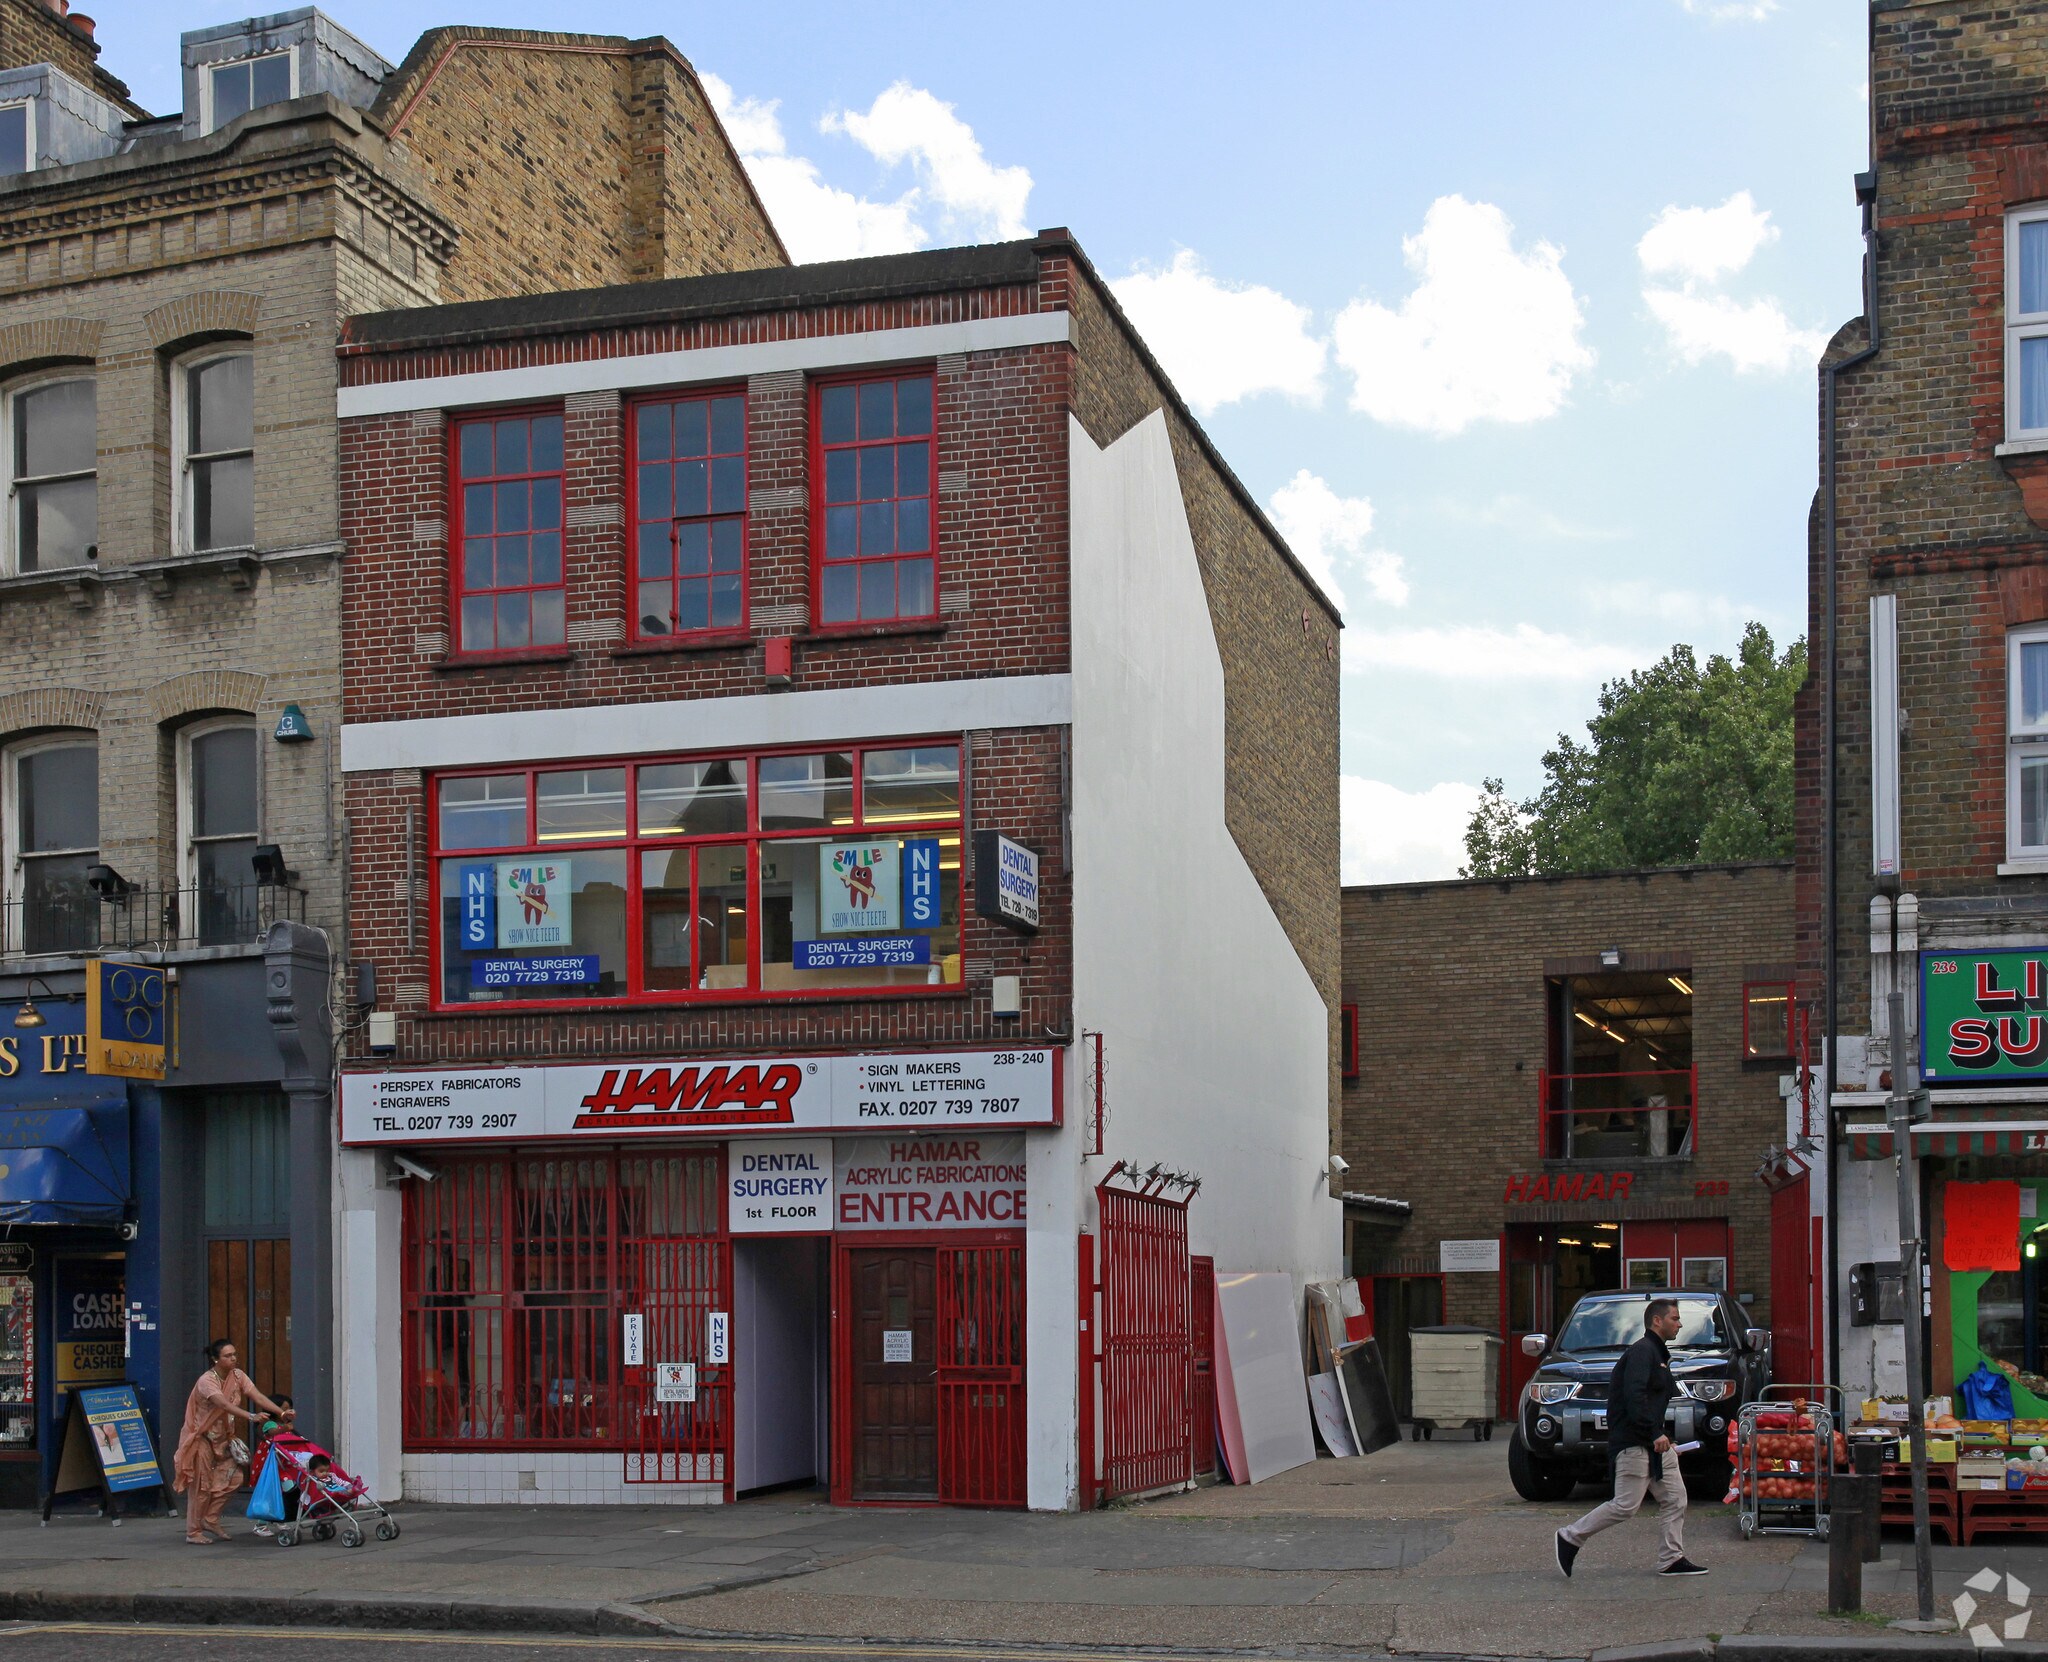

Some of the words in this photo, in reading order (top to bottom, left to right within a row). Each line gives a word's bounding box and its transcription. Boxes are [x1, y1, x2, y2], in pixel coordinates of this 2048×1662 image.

[1002, 844, 1033, 877] DENTAL
[912, 847, 931, 920] NHS
[1000, 868, 1037, 902] SURGERY
[468, 872, 486, 942] NHS
[832, 912, 849, 928] SHOW
[850, 911, 865, 927] NICE
[866, 910, 887, 926] TEETH
[508, 928, 525, 944] SHOW
[525, 928, 540, 943] NICE
[540, 926, 560, 942] TEETH
[808, 942, 853, 954] DENTAL
[857, 939, 914, 951] SURGERY
[485, 961, 528, 972] DENTAL
[531, 958, 584, 970] SURGERY
[808, 955, 835, 966] 020
[840, 953, 876, 965] 7729
[881, 951, 915, 963] 7319
[1931, 960, 1957, 975] 236
[485, 973, 511, 984] 020
[516, 971, 549, 982] 7729
[554, 970, 585, 981] 7319
[993, 1052, 1045, 1065] 238-240
[867, 1064, 898, 1076] SIGN
[906, 1062, 961, 1074] MAKERS
[380, 1080, 434, 1093] PERSPEX
[441, 1077, 521, 1091] FABRICATORS
[580, 1063, 803, 1114] HAMAR
[868, 1080, 904, 1093] VINYL
[912, 1078, 986, 1092] LETTERING
[380, 1096, 450, 1109] ENGRAVERS
[859, 1102, 894, 1117] FAX.
[899, 1101, 937, 1116] 0207
[945, 1099, 973, 1114] 739
[981, 1098, 1020, 1113] 7807
[408, 1116, 442, 1131] 0207
[447, 1115, 474, 1130] 739
[481, 1113, 517, 1128] 2907
[578, 1116, 635, 1126] ACRYLIC
[644, 1113, 746, 1124] FABRICATIONS
[758, 1112, 780, 1121] LTD
[890, 1140, 981, 1163] HAMAR
[742, 1153, 820, 1172] DENTAL
[846, 1166, 912, 1185] ACRYLIC
[916, 1164, 1026, 1184] FABRICATIONS
[733, 1177, 828, 1197] SURGERY
[1503, 1171, 1634, 1204] HAMAR
[1695, 1180, 1729, 1197] 238
[745, 1207, 762, 1218] 1st
[771, 1206, 817, 1218] FLOOR
[839, 1189, 1026, 1223] ENTRANCE
[72, 1293, 126, 1313] CASH
[73, 1313, 126, 1329] LOANS
[25, 1329, 34, 1361] SALE
[713, 1317, 724, 1358] NHS
[72, 1344, 126, 1356] CHEQUES
[73, 1356, 126, 1370] CASHED
[25, 1367, 34, 1399] SALE
[90, 1413, 117, 1423] CHEQUES
[117, 1410, 138, 1420] CASHED
